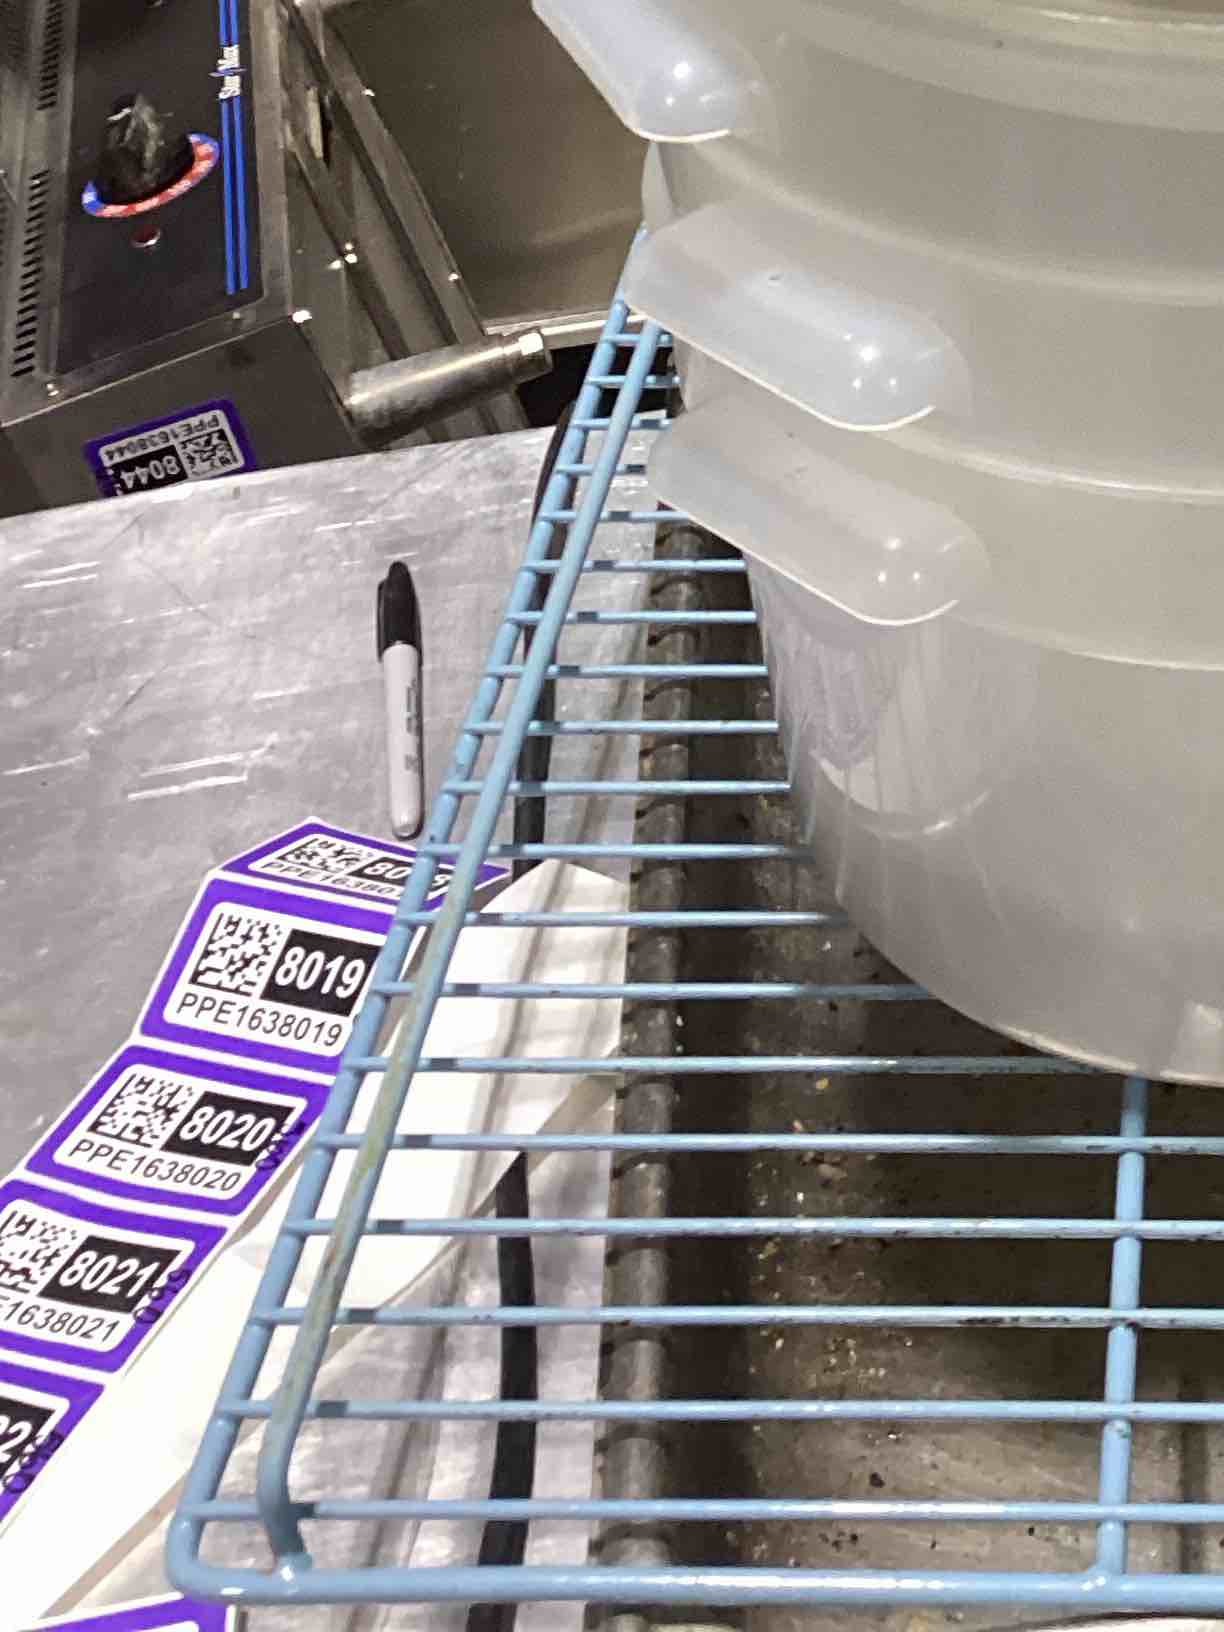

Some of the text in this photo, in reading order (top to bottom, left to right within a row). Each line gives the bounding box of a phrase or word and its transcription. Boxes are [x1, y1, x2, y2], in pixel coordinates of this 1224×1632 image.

[120, 455, 182, 489] 8044
[274, 946, 366, 999] 8019
[176, 992, 343, 1047] PPE1638019
[179, 1106, 275, 1151] 8020
[68, 1138, 241, 1192] PPE1638020
[59, 1250, 161, 1299] 8021
